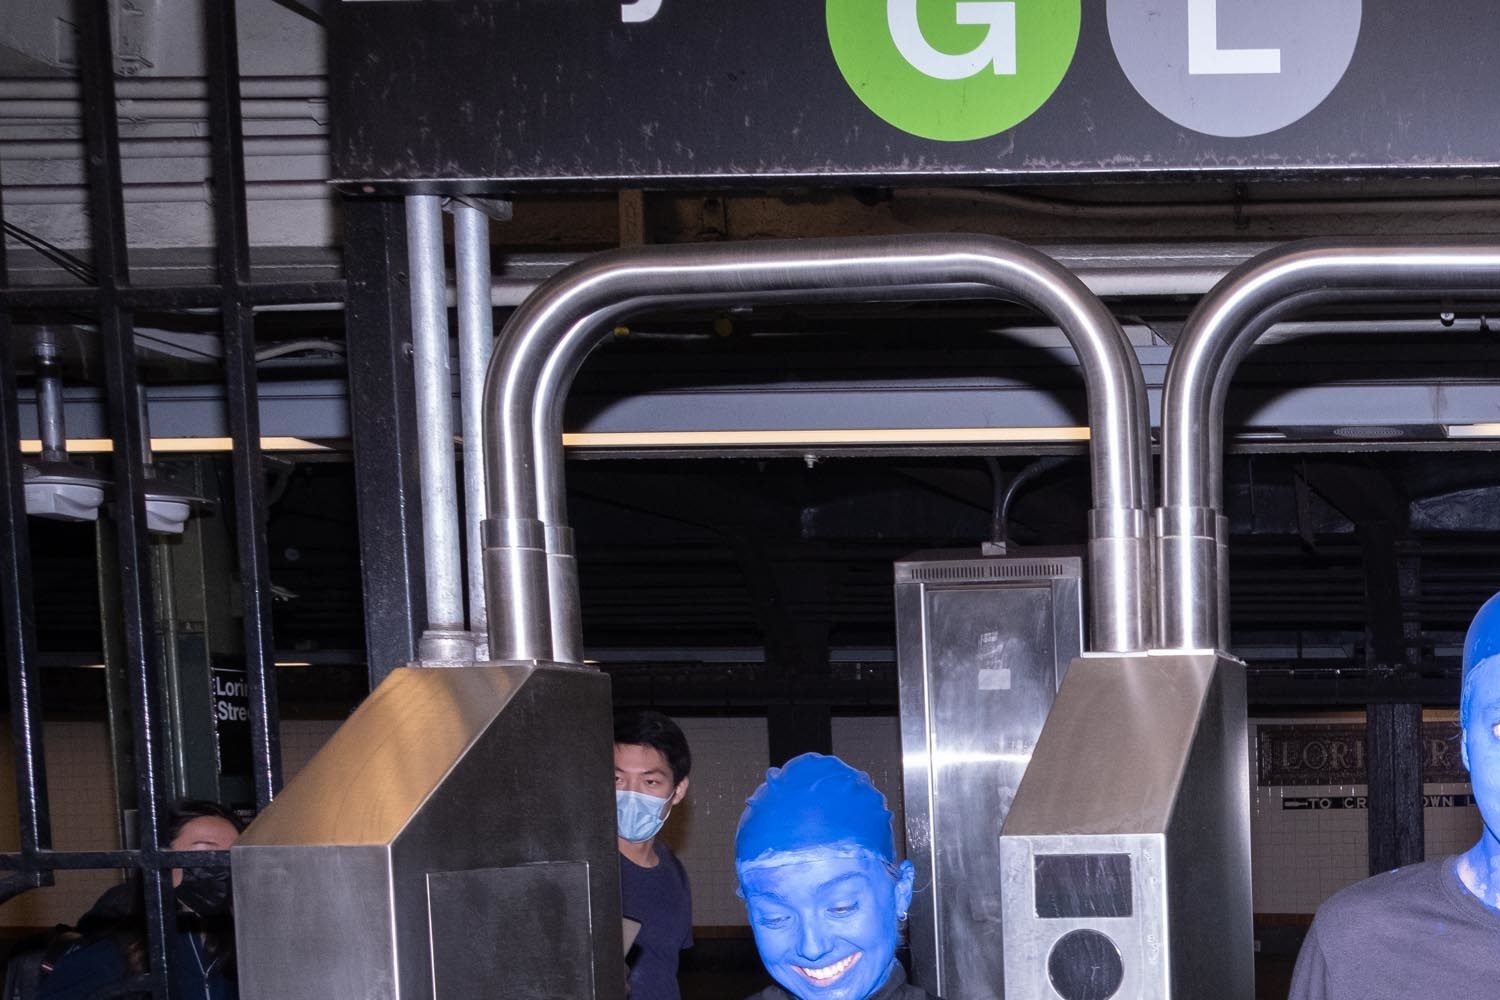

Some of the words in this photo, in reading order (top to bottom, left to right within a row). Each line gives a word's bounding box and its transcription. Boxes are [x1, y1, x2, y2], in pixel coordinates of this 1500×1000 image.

[886, 0, 1017, 80] G
[1188, 0, 1281, 75] L
[216, 676, 247, 697] Lori
[218, 700, 250, 721] Stre
